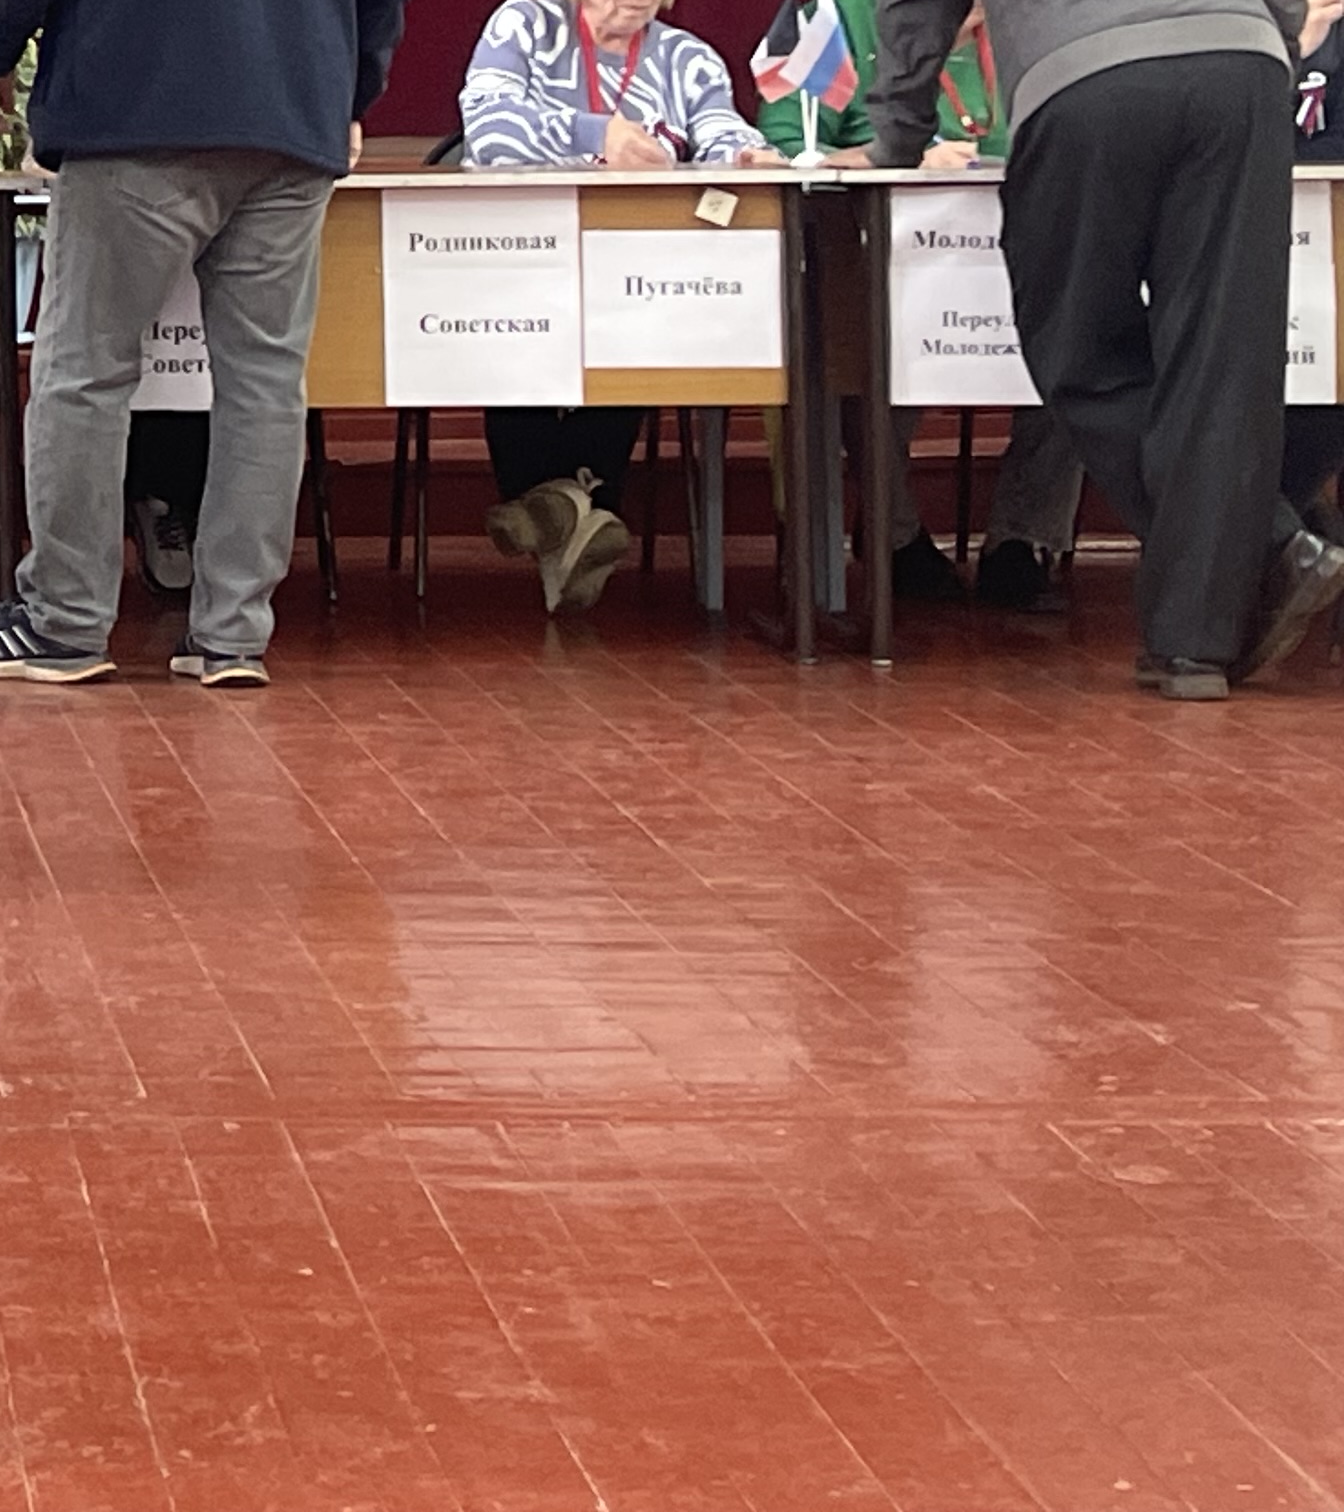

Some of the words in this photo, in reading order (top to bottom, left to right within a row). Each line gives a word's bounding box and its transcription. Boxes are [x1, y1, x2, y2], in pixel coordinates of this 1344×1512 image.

[408, 231, 557, 254] Родниковая
[912, 230, 1001, 250] Молод
[624, 275, 743, 302] Пугачёва
[419, 313, 550, 335] Советская
[920, 338, 1021, 356] Молодеж
